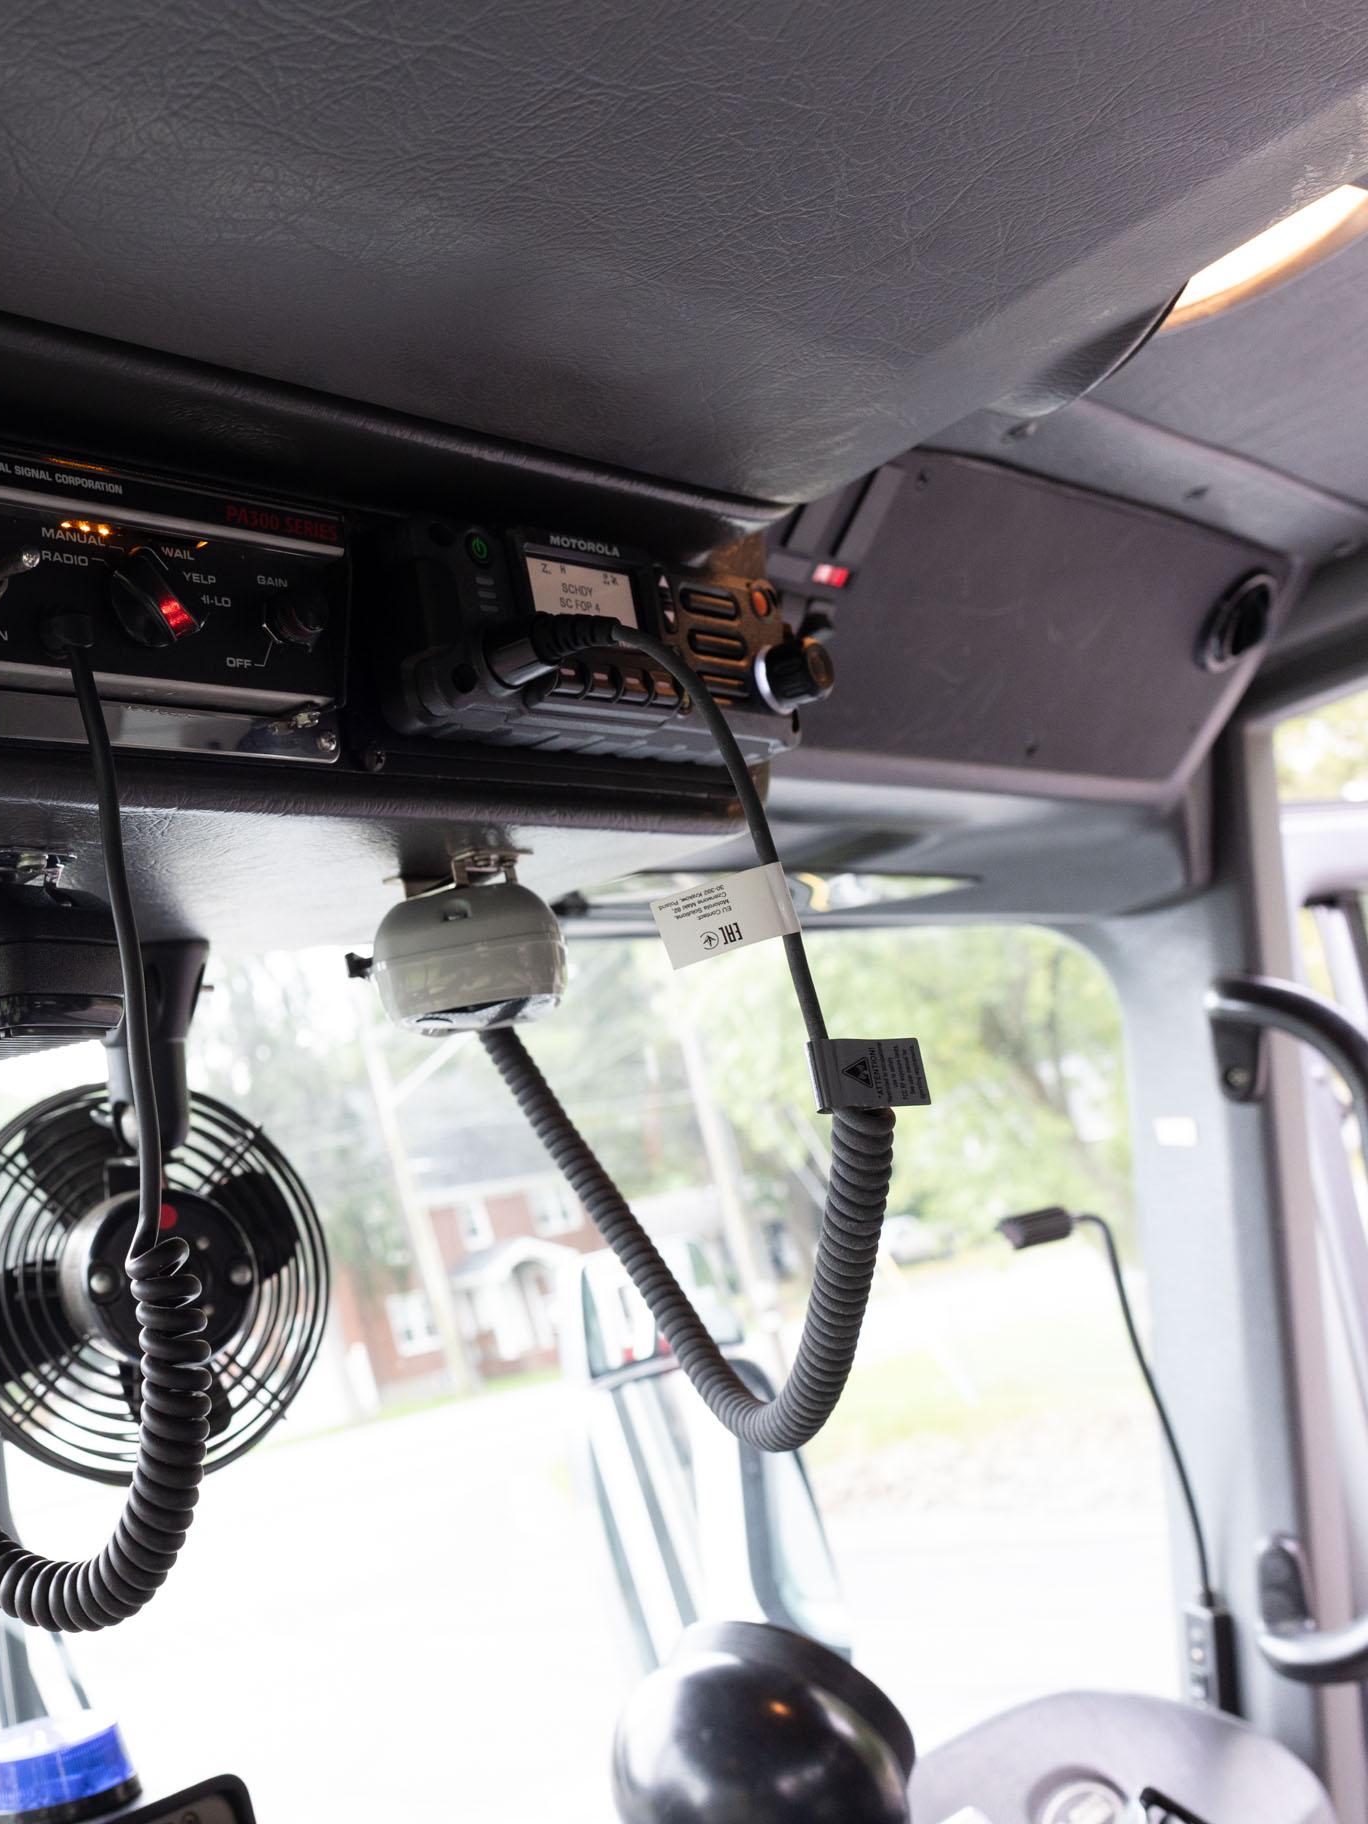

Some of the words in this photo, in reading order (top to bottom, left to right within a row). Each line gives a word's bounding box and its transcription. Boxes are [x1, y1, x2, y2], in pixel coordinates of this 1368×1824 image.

[14, 465, 53, 481] SIGNAL
[55, 473, 123, 494] CORPORATION
[225, 504, 281, 529] PA300
[283, 516, 338, 543] SERIES
[41, 527, 106, 547] MANUAL
[161, 545, 195, 561] WAIL
[549, 535, 621, 558] MOTOROLA
[41, 550, 89, 567] RADIO
[182, 571, 217, 585] YELP
[256, 574, 288, 589] GAIN
[226, 656, 252, 670] OFF
